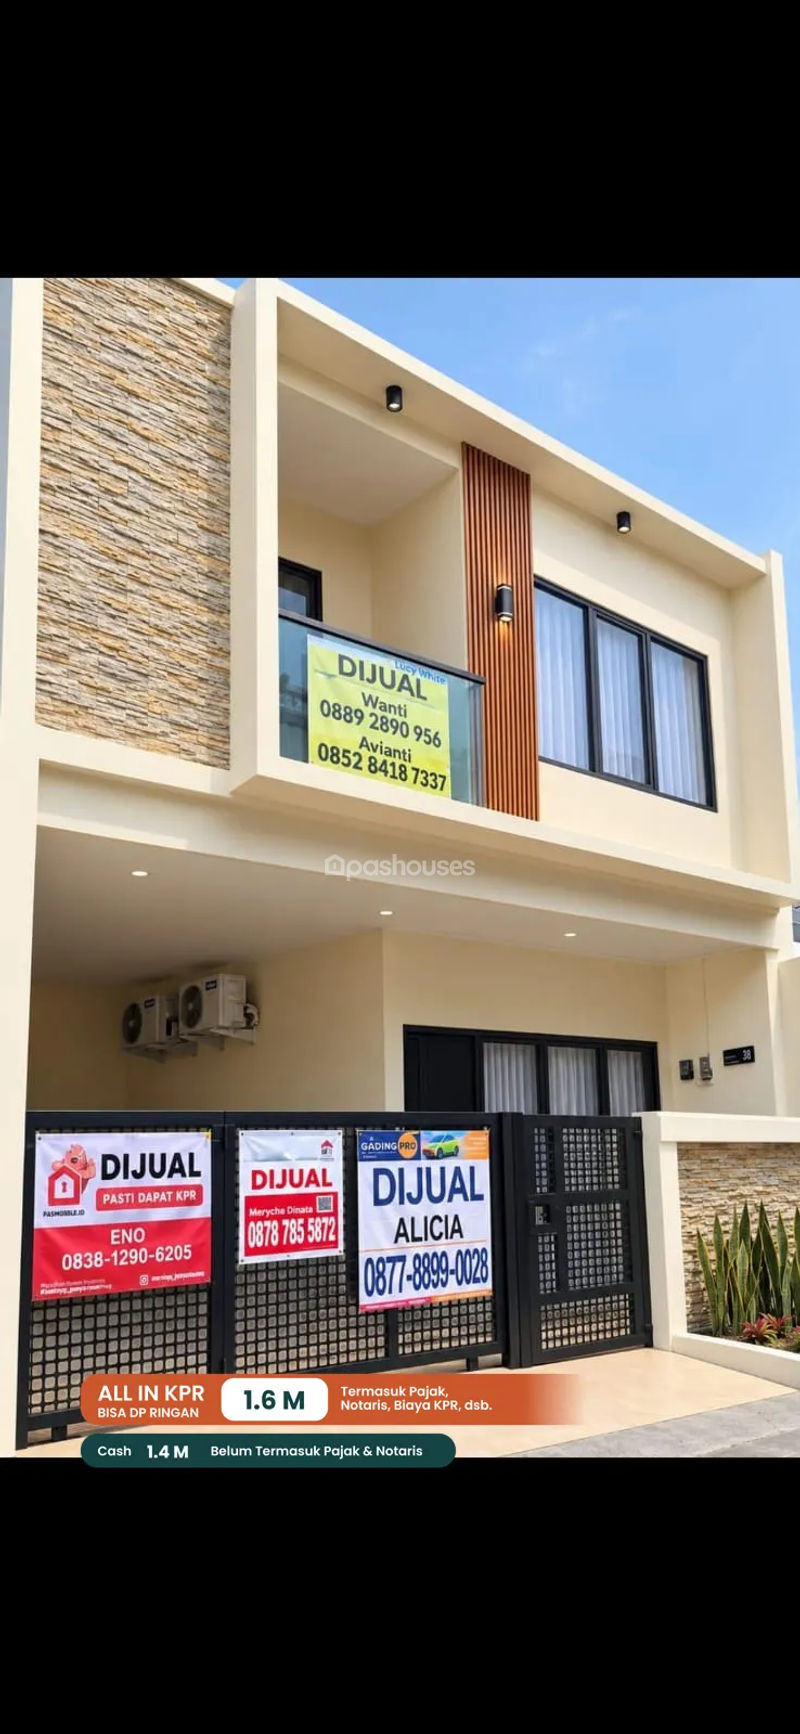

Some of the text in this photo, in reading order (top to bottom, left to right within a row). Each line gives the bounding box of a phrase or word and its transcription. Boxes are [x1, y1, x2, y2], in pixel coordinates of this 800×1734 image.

[337, 653, 427, 701] DIJUAL
[394, 660, 446, 684] Lucy White
[361, 691, 407, 718] Wanti
[320, 699, 442, 748] 0889 2890 956
[358, 736, 412, 763] Avianti
[317, 742, 447, 792] 0852 8418 7337
[361, 1141, 417, 1151] GADING PRO
[100, 1152, 202, 1181] DIJUAL
[251, 1168, 333, 1191] DIJUAL
[102, 1190, 197, 1205] PASTI DAPAT KPR
[373, 1166, 484, 1206] DIJUAL
[287, 1206, 314, 1215] Dinata
[110, 1227, 146, 1246] ENO
[248, 1216, 336, 1248] 0878 785 5872
[394, 1214, 464, 1244] ALICIA
[61, 1244, 193, 1271] 0838-1290-6205
[364, 1247, 489, 1297] 0877-8899-0028
